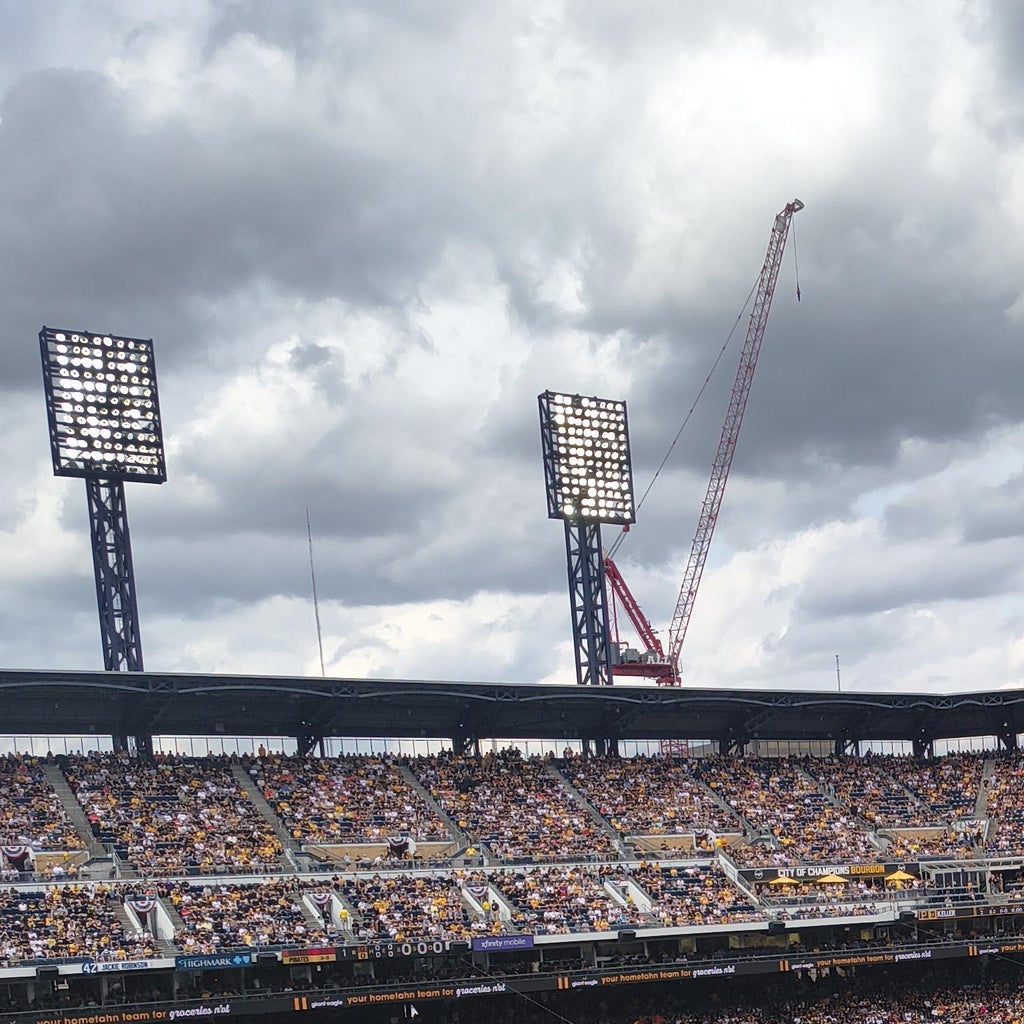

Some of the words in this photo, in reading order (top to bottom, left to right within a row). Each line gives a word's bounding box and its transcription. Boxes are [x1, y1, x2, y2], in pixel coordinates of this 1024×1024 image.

[778, 869, 795, 877] CITY
[797, 868, 806, 876] OF
[808, 866, 850, 876] CHAMPIONS
[851, 865, 884, 874] BOURBON
[417, 943, 427, 954] 0
[433, 942, 442, 953] 0
[481, 940, 502, 948] xfinity
[504, 938, 526, 946] mobile
[402, 944, 411, 955] 0
[180, 958, 231, 968] HIGHMARK
[817, 959, 831, 967] your
[833, 956, 865, 965] hometahn
[83, 963, 97, 974] 42
[620, 972, 658, 982] hometahn
[693, 967, 722, 978] groceries
[347, 995, 367, 1004] your
[370, 991, 414, 1001] hometahn
[418, 990, 440, 998] team
[456, 985, 491, 997] groceries
[328, 999, 343, 1007] eagle
[122, 1011, 150, 1021] team
[152, 1010, 167, 1018] for
[169, 1006, 212, 1020] groceries
